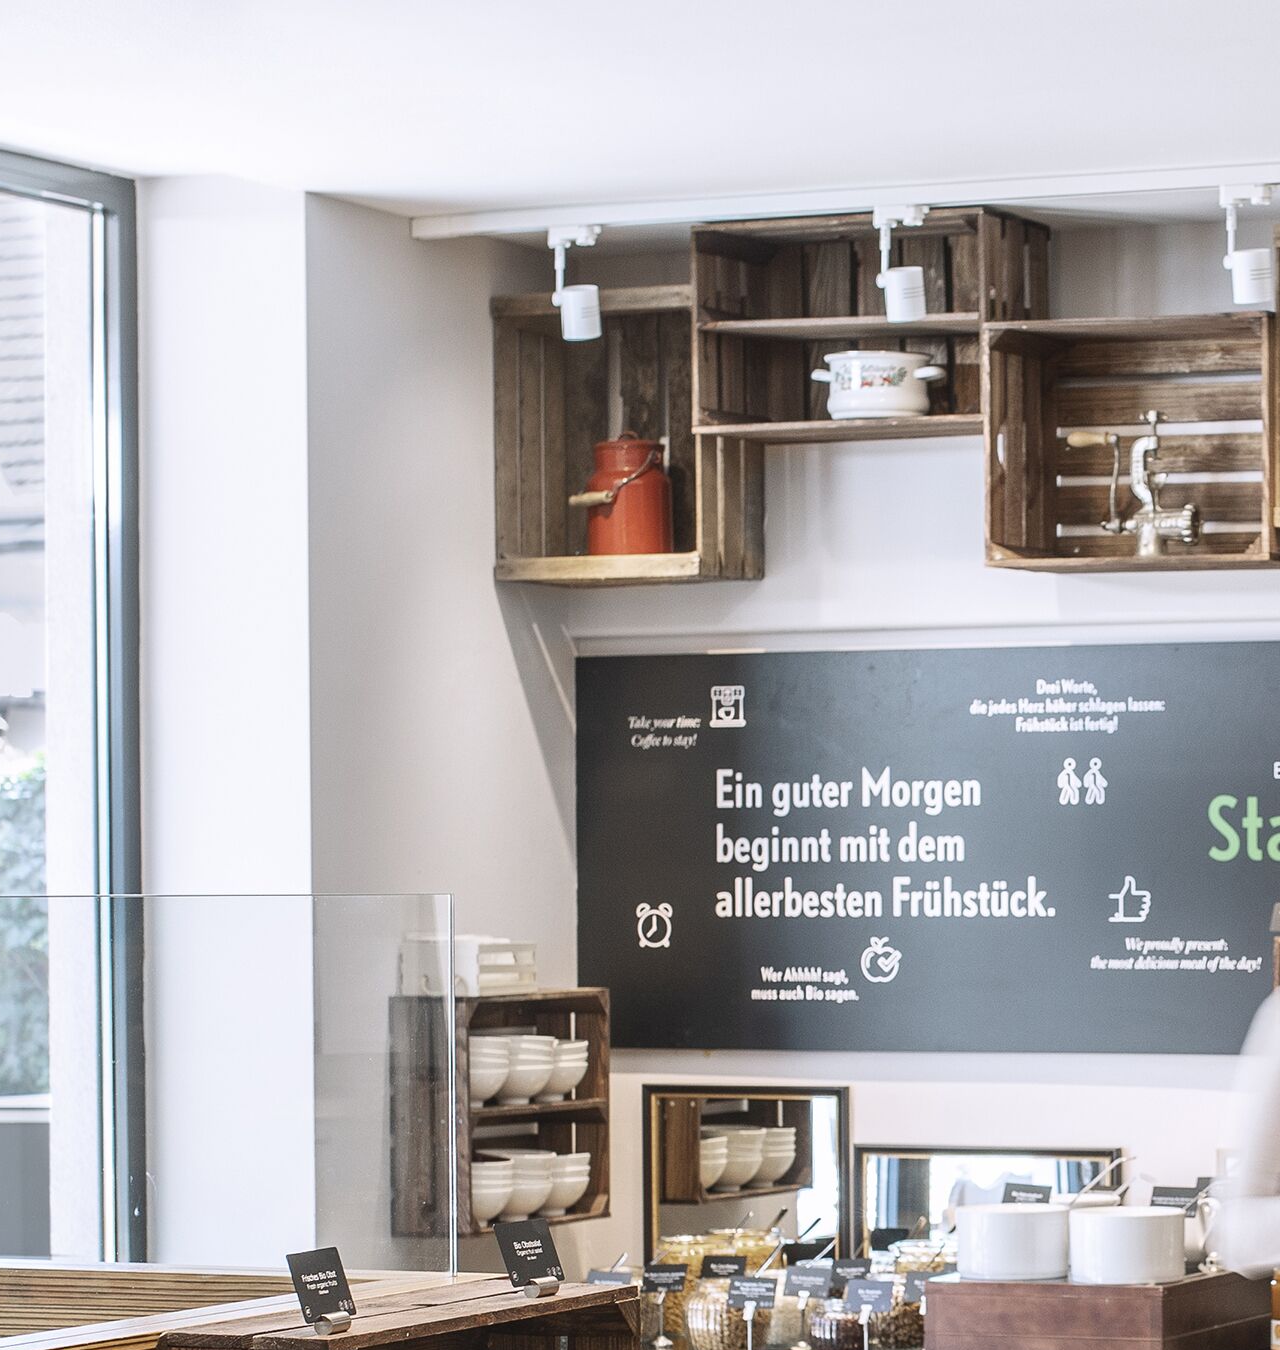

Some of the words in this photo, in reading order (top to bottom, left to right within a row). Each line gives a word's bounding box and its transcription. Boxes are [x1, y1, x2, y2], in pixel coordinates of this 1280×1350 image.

[1036, 678, 1060, 695] Drei
[969, 699, 987, 715] die
[987, 698, 1017, 717] jedes
[1018, 698, 1044, 714] Herz
[1078, 697, 1126, 715] schlagen
[628, 716, 651, 729] Take
[1015, 716, 1068, 732] Frühstück
[1069, 716, 1084, 731] ist
[630, 733, 662, 750] Coffee
[662, 735, 672, 746] to
[716, 768, 762, 809] Ein
[772, 771, 853, 817] guter
[861, 766, 982, 816] Morgen
[716, 823, 831, 872] beginnt
[840, 825, 890, 863] mit
[897, 821, 965, 863] dem
[716, 875, 883, 919] allerbesten
[893, 876, 1056, 918] Frühstück.
[1142, 937, 1185, 955] proudly
[761, 966, 783, 982] Wer
[751, 989, 778, 1000] muss
[778, 985, 804, 1000] auch
[805, 985, 824, 1000] Bio
